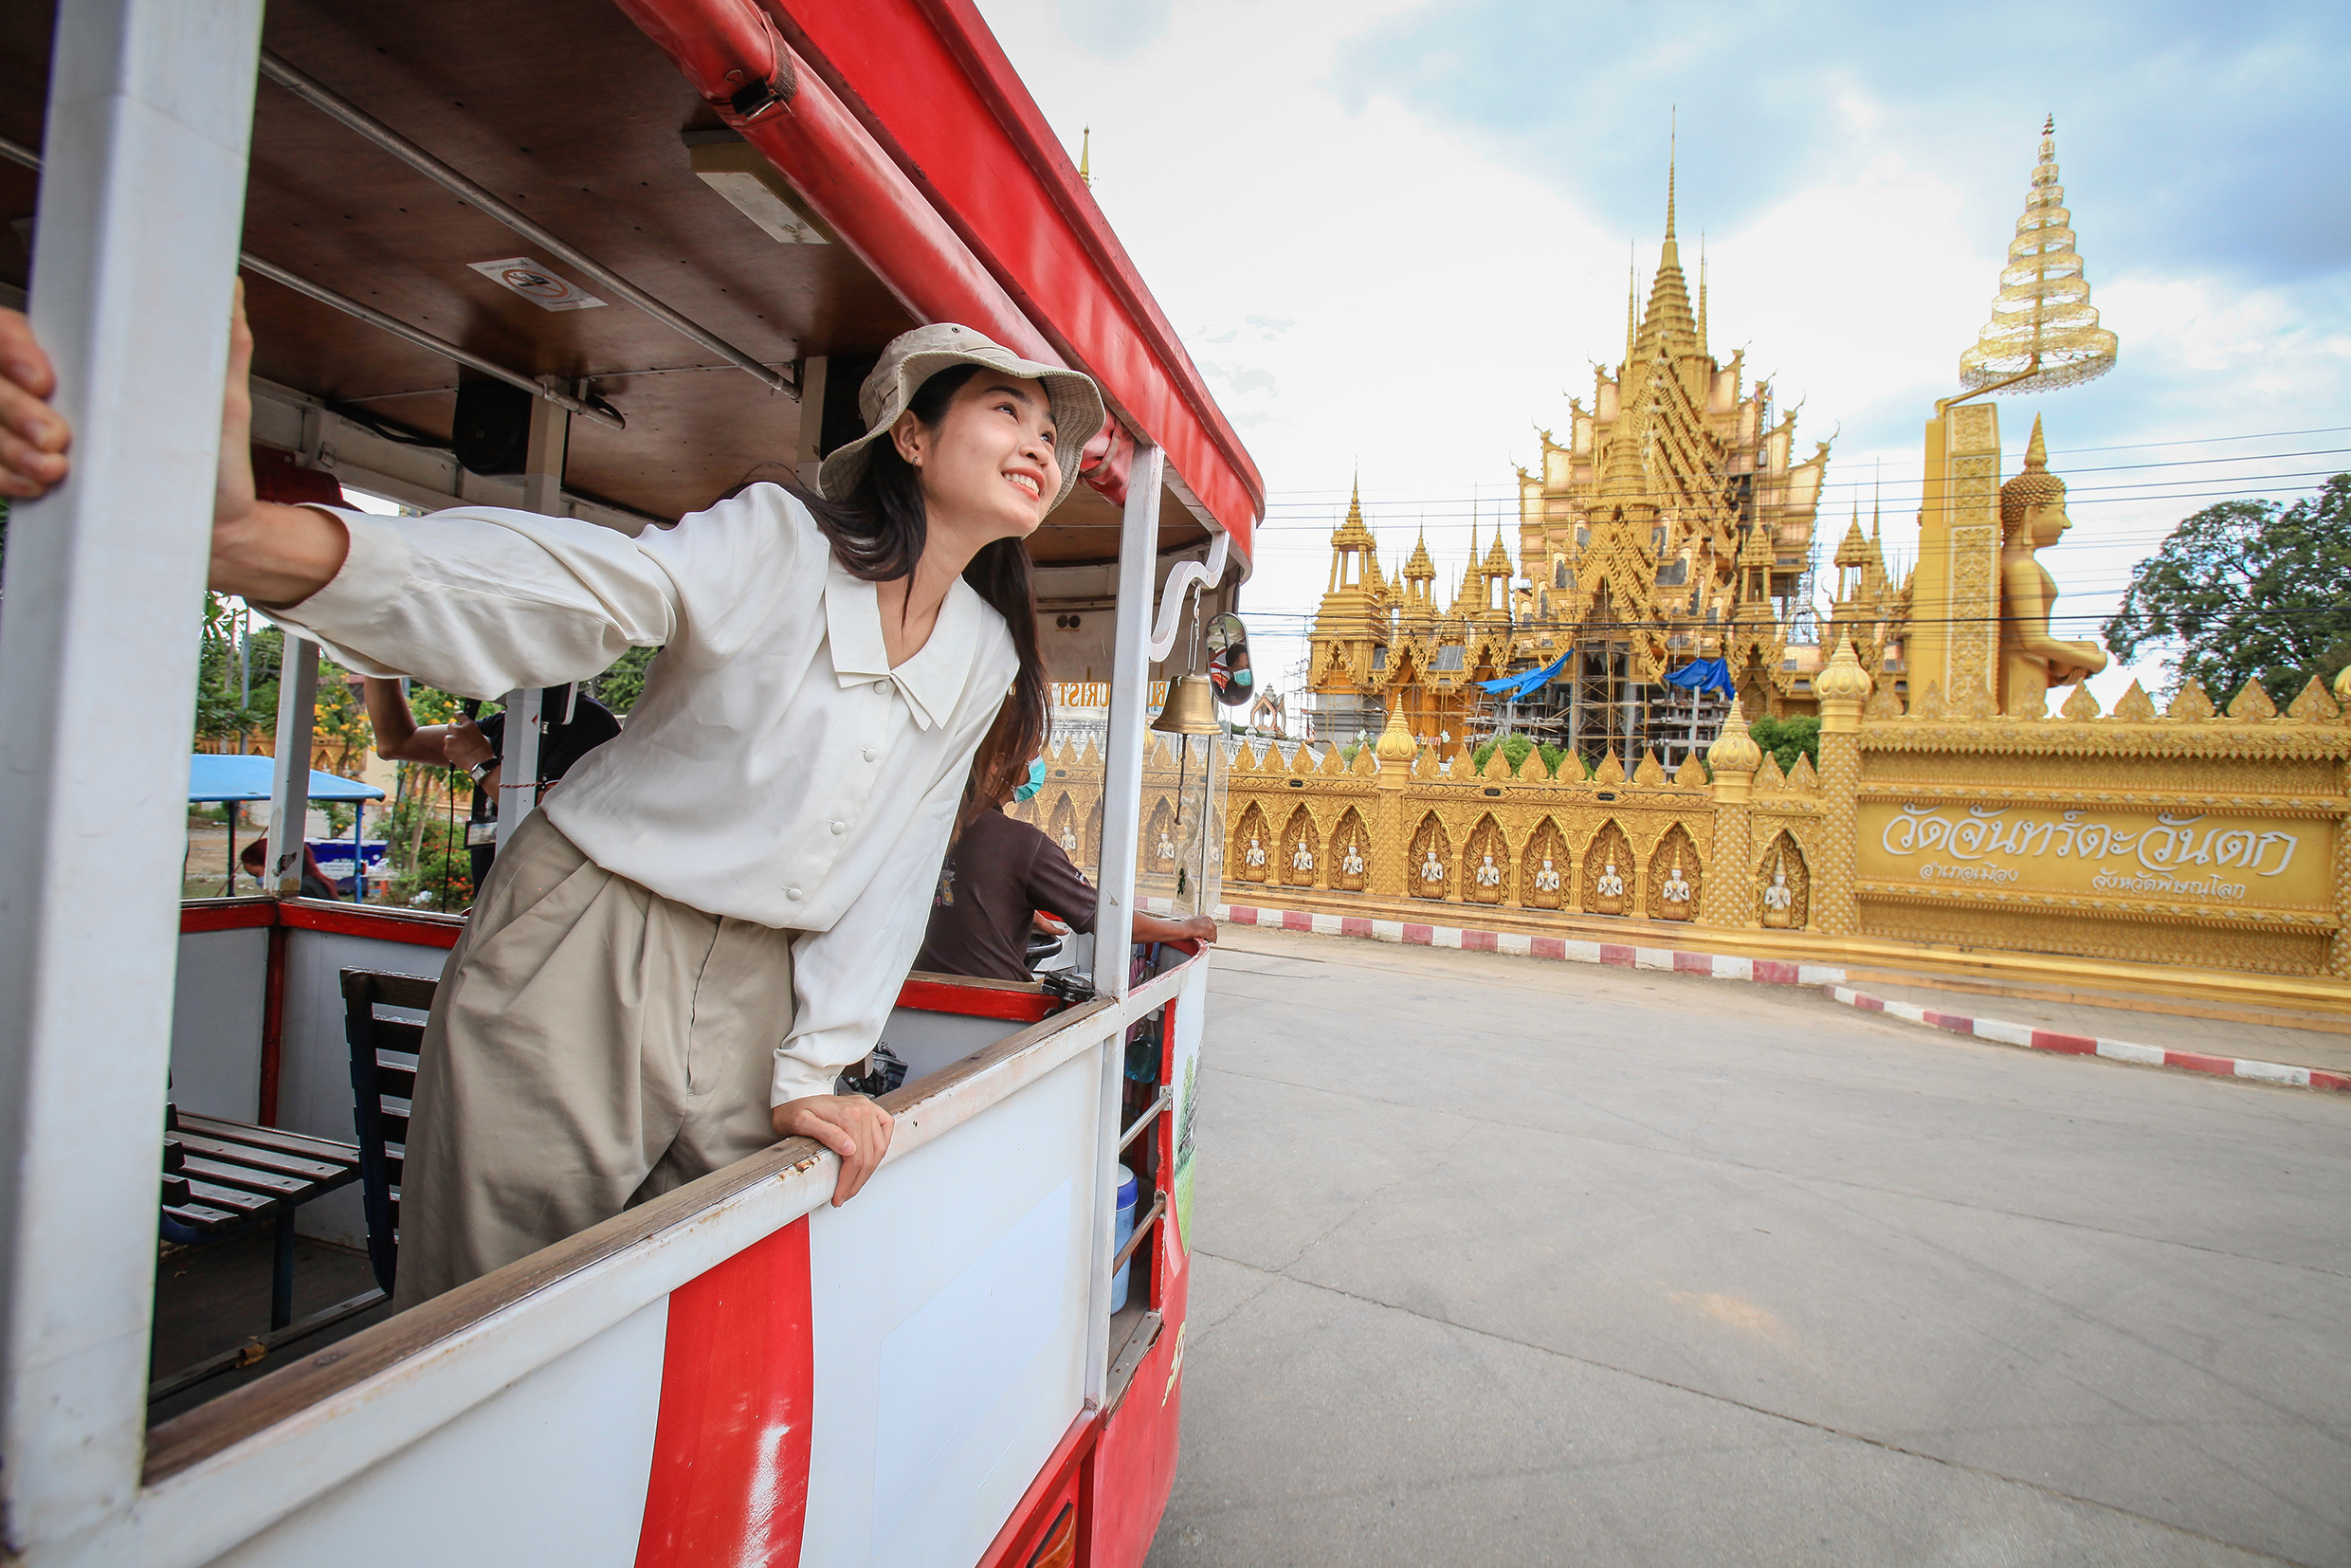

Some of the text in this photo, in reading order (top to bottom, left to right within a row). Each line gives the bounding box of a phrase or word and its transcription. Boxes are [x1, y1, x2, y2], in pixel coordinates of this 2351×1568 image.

[1883, 802, 2298, 876] วัดจันทร์ตะวันตก
[1920, 862, 2019, 884] อำเภอเมือง
[2092, 867, 2246, 899] จังหวัดพิษณุโลก
